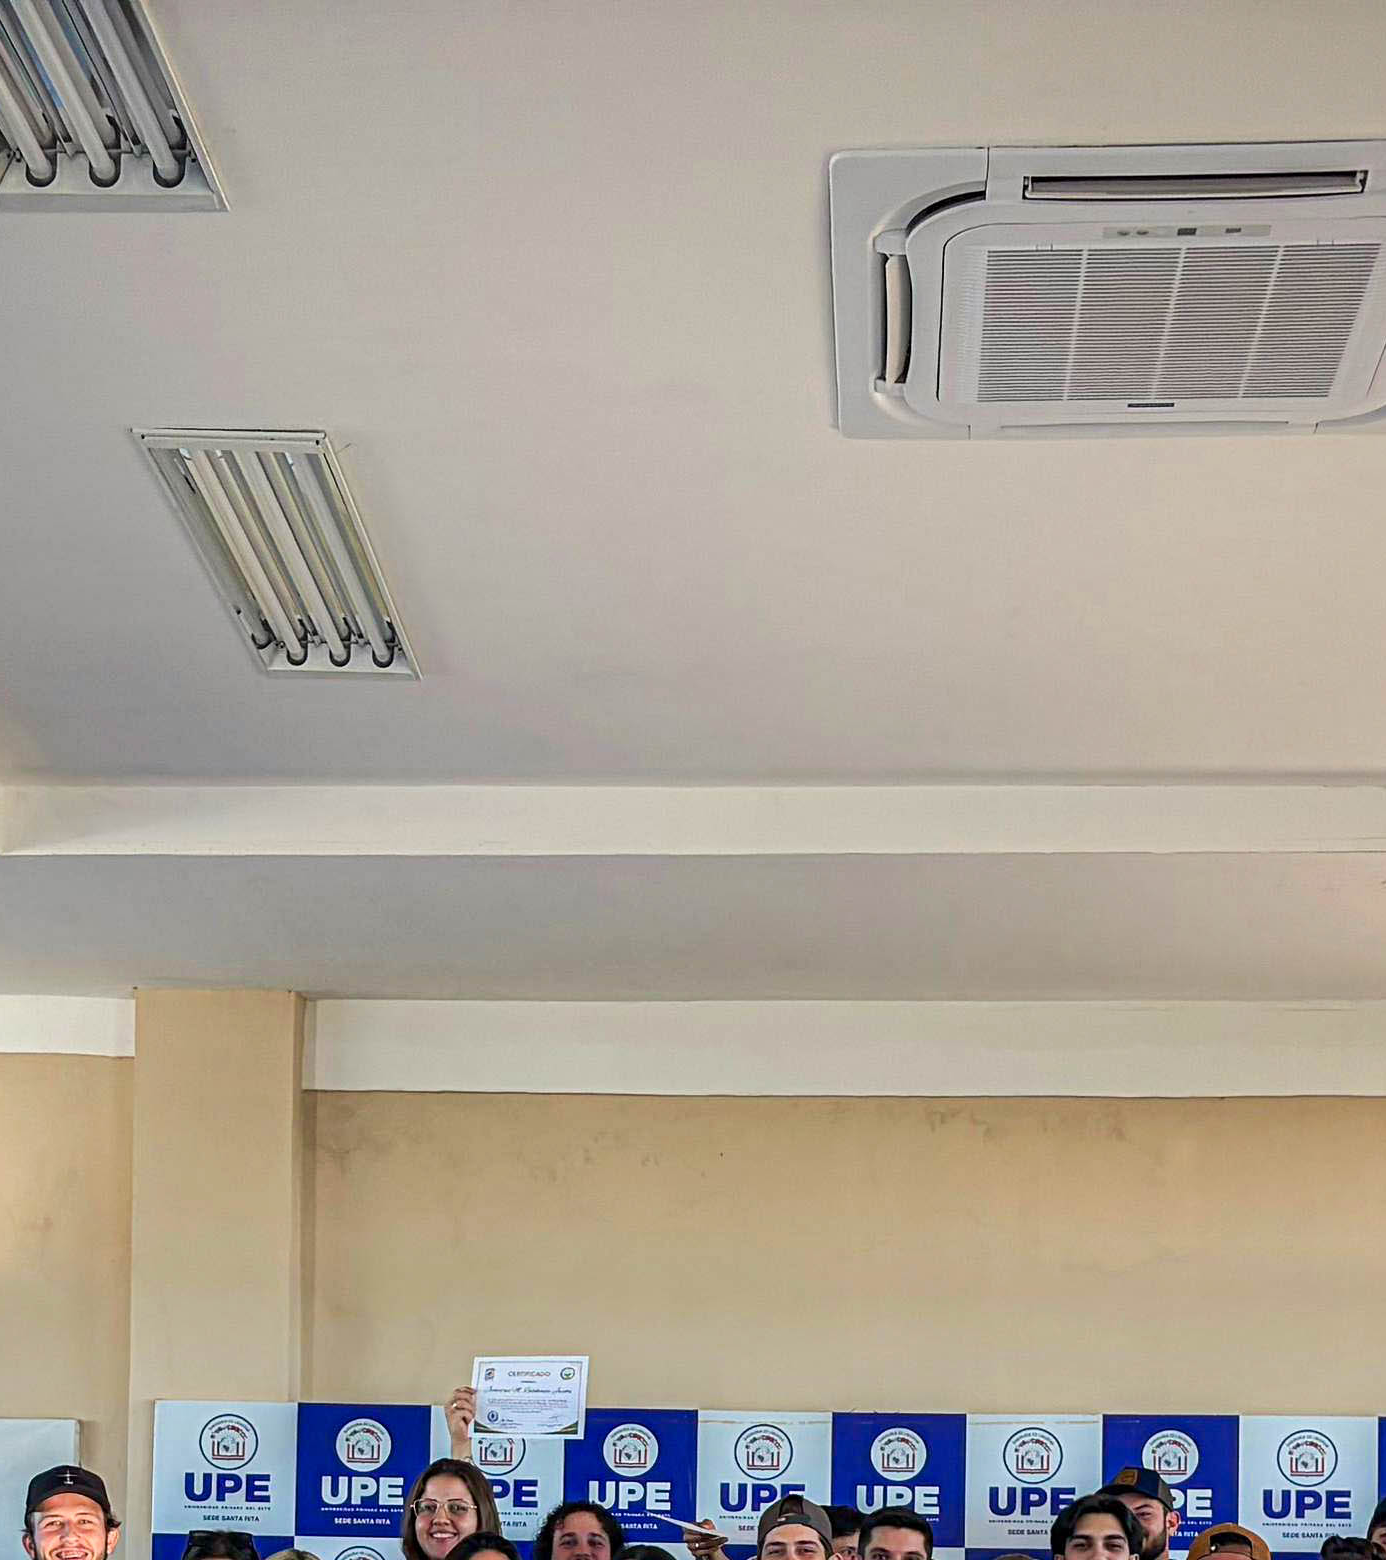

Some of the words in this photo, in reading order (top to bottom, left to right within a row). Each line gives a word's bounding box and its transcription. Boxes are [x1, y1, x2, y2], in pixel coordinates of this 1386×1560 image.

[184, 1472, 271, 1503] UPE
[321, 1475, 404, 1505] UPE
[486, 1479, 538, 1508] PE
[588, 1480, 671, 1510] UPE
[856, 1485, 940, 1515] UPE
[988, 1486, 1076, 1516] UPE
[1262, 1489, 1352, 1520] UPE
